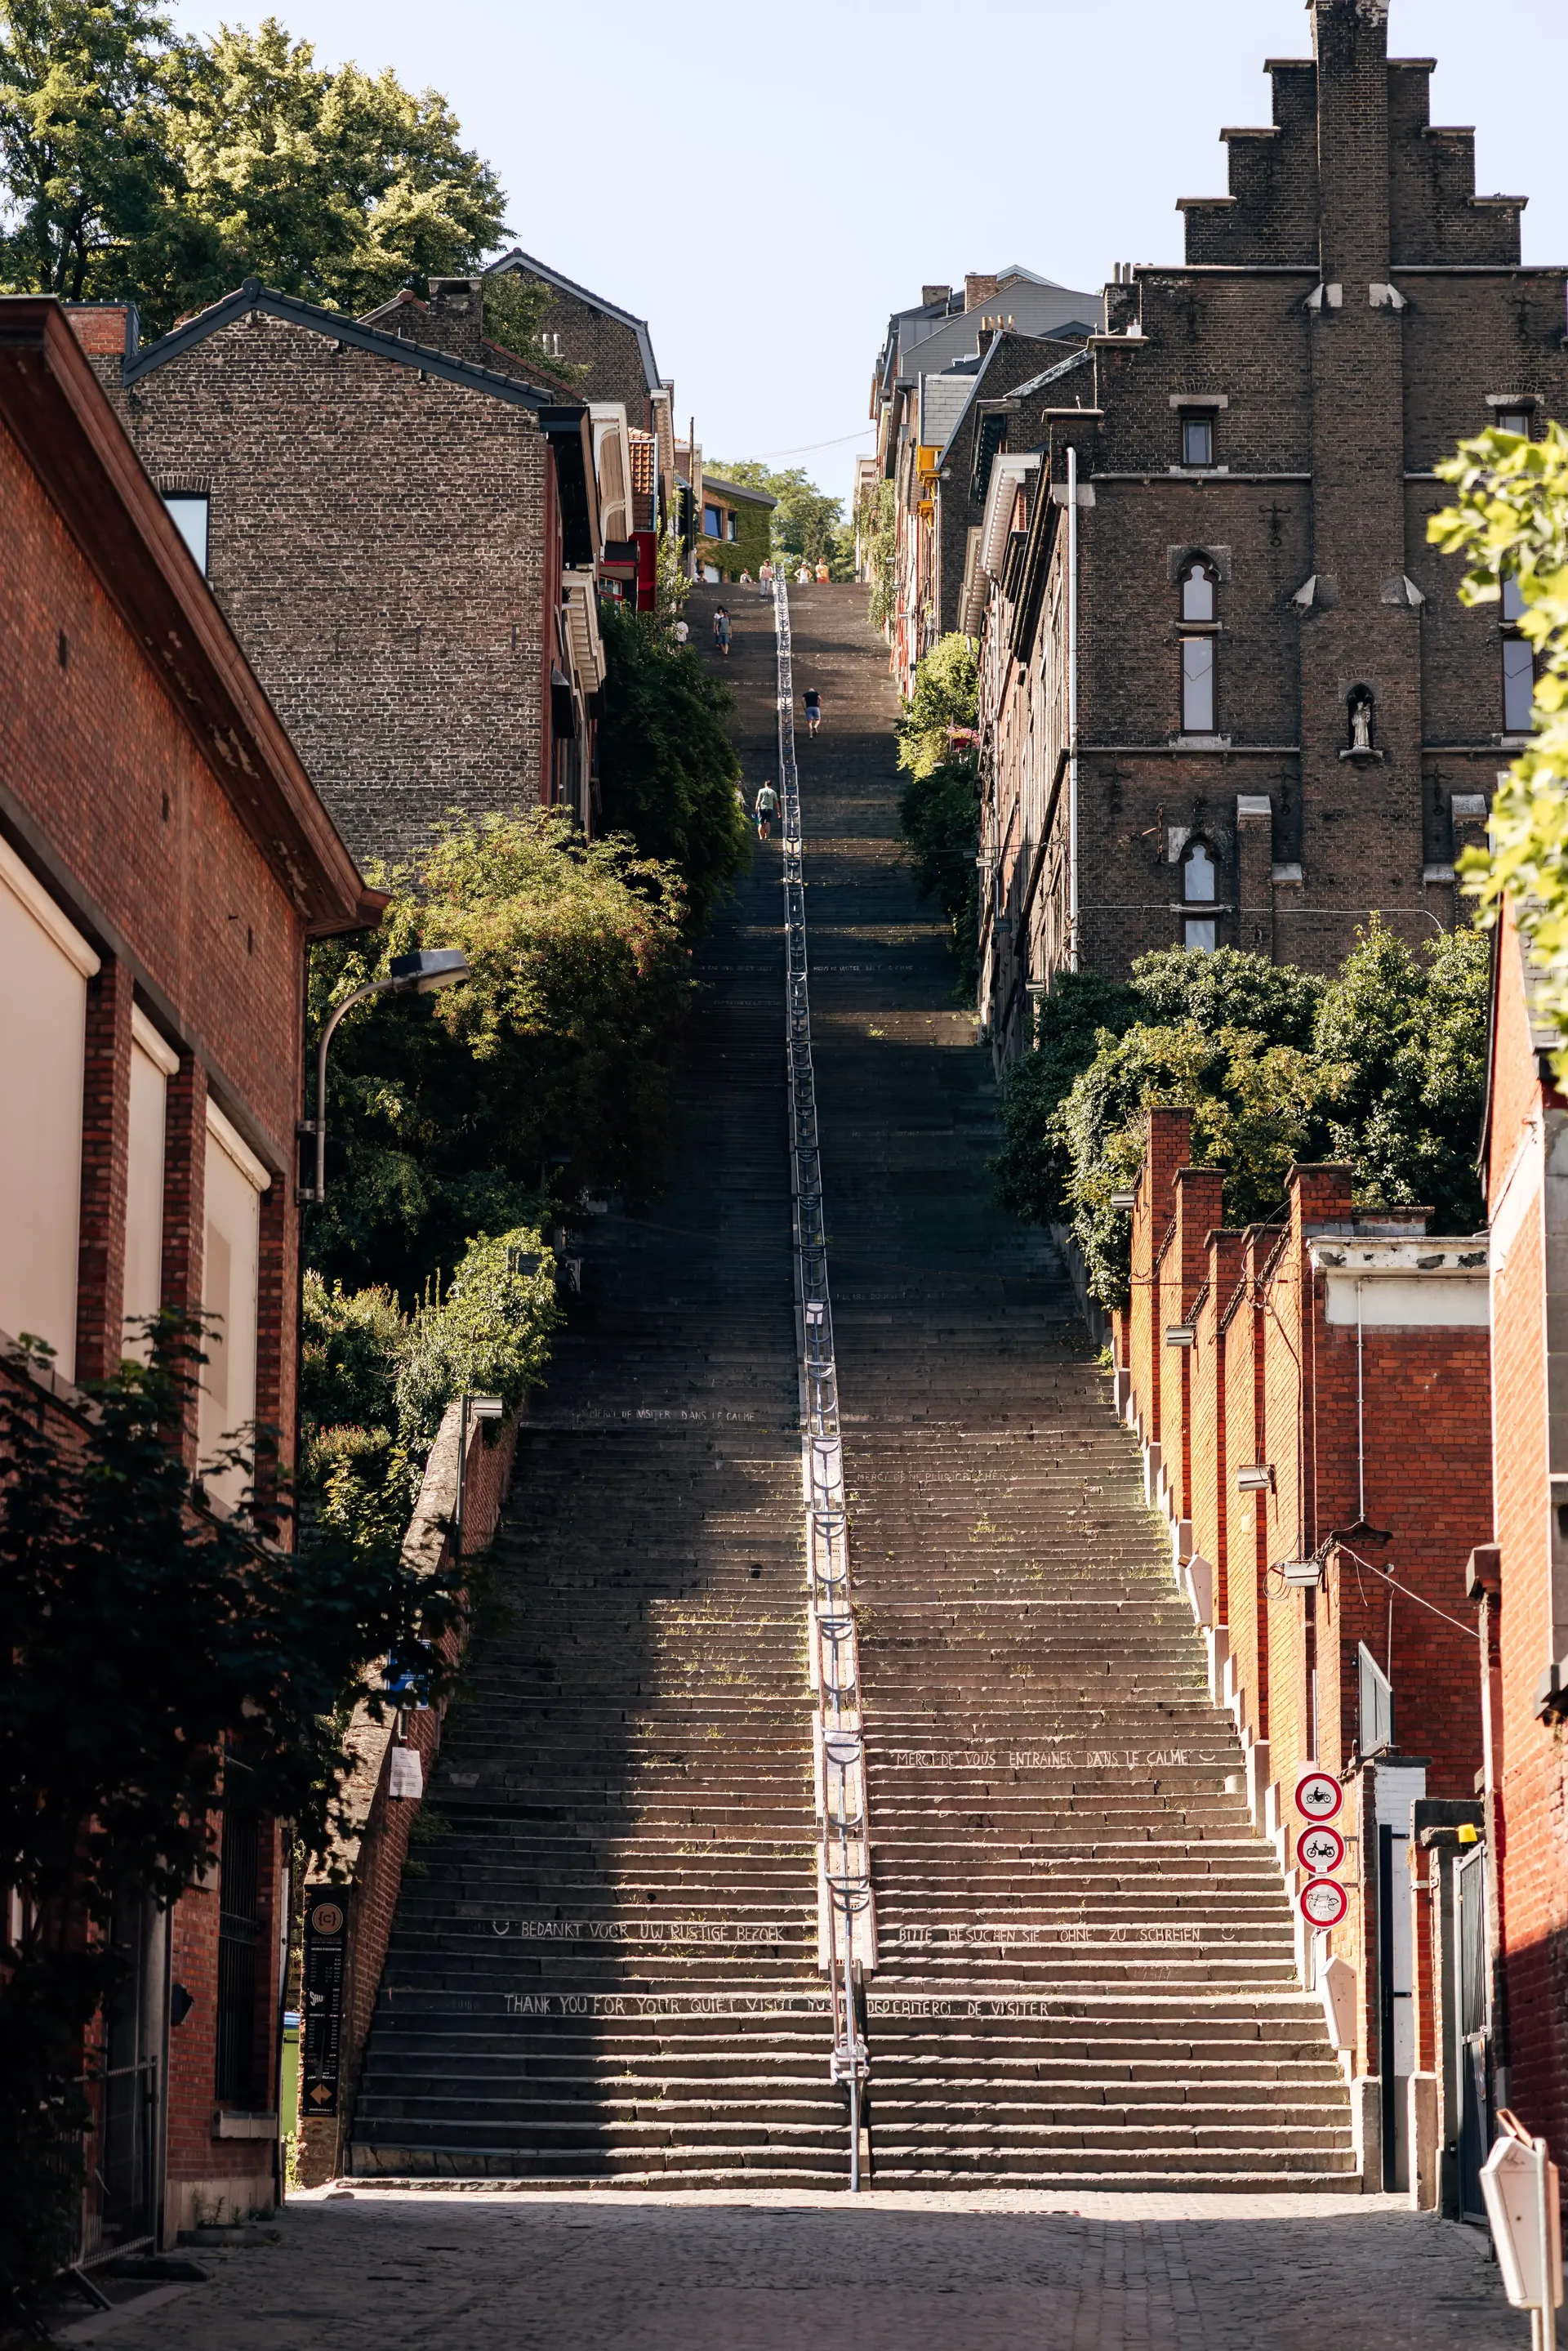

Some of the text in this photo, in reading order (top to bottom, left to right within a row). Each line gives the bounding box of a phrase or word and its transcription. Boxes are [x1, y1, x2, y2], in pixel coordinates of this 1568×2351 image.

[940, 1752, 956, 1766] DE
[964, 1752, 997, 1766] VOUS
[1086, 1751, 1119, 1765] DANS
[1125, 1751, 1140, 1765] LE
[1147, 1751, 1188, 1765] CALME
[521, 1921, 785, 1942] BEDANKT VOOR UW RUSTIGE BEZOEK
[948, 1928, 1016, 1943] BESUCHEN
[1060, 1929, 1094, 1943] OHNE
[1109, 1929, 1127, 1942] ZU
[503, 1994, 551, 2014] THANK
[559, 1995, 588, 2014] YOU
[593, 1996, 626, 2015] FOR
[636, 1997, 679, 2014] YOUR
[690, 1998, 735, 2014] QUIET
[967, 2001, 982, 2016] DE
